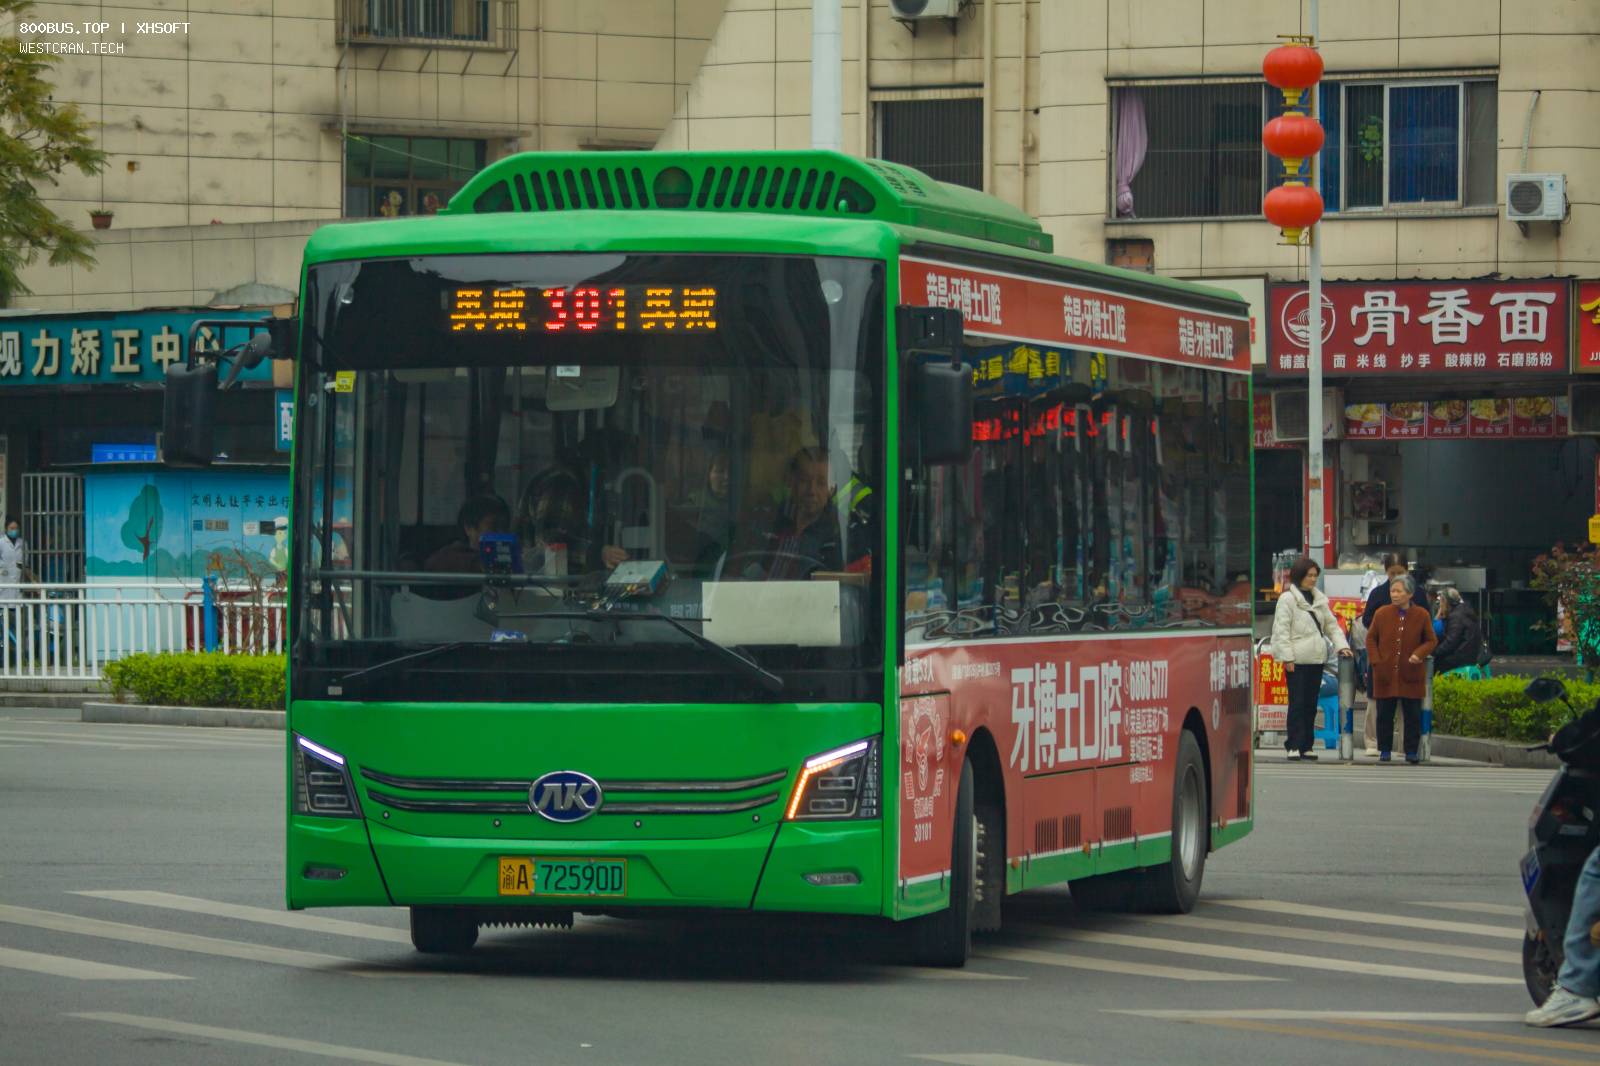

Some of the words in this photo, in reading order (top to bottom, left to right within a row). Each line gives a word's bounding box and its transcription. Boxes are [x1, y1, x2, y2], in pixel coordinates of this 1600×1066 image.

[543, 288, 625, 330] 301
[1350, 288, 1557, 346] 骨香面
[1279, 353, 1310, 369] 铺盖
[1356, 353, 1387, 369] 米线
[1400, 352, 1431, 368] 抄手
[1444, 351, 1487, 368] 酸辣粉
[1496, 351, 1553, 368] 石磨肠粉
[1010, 659, 1123, 772] 牙博士口腔
